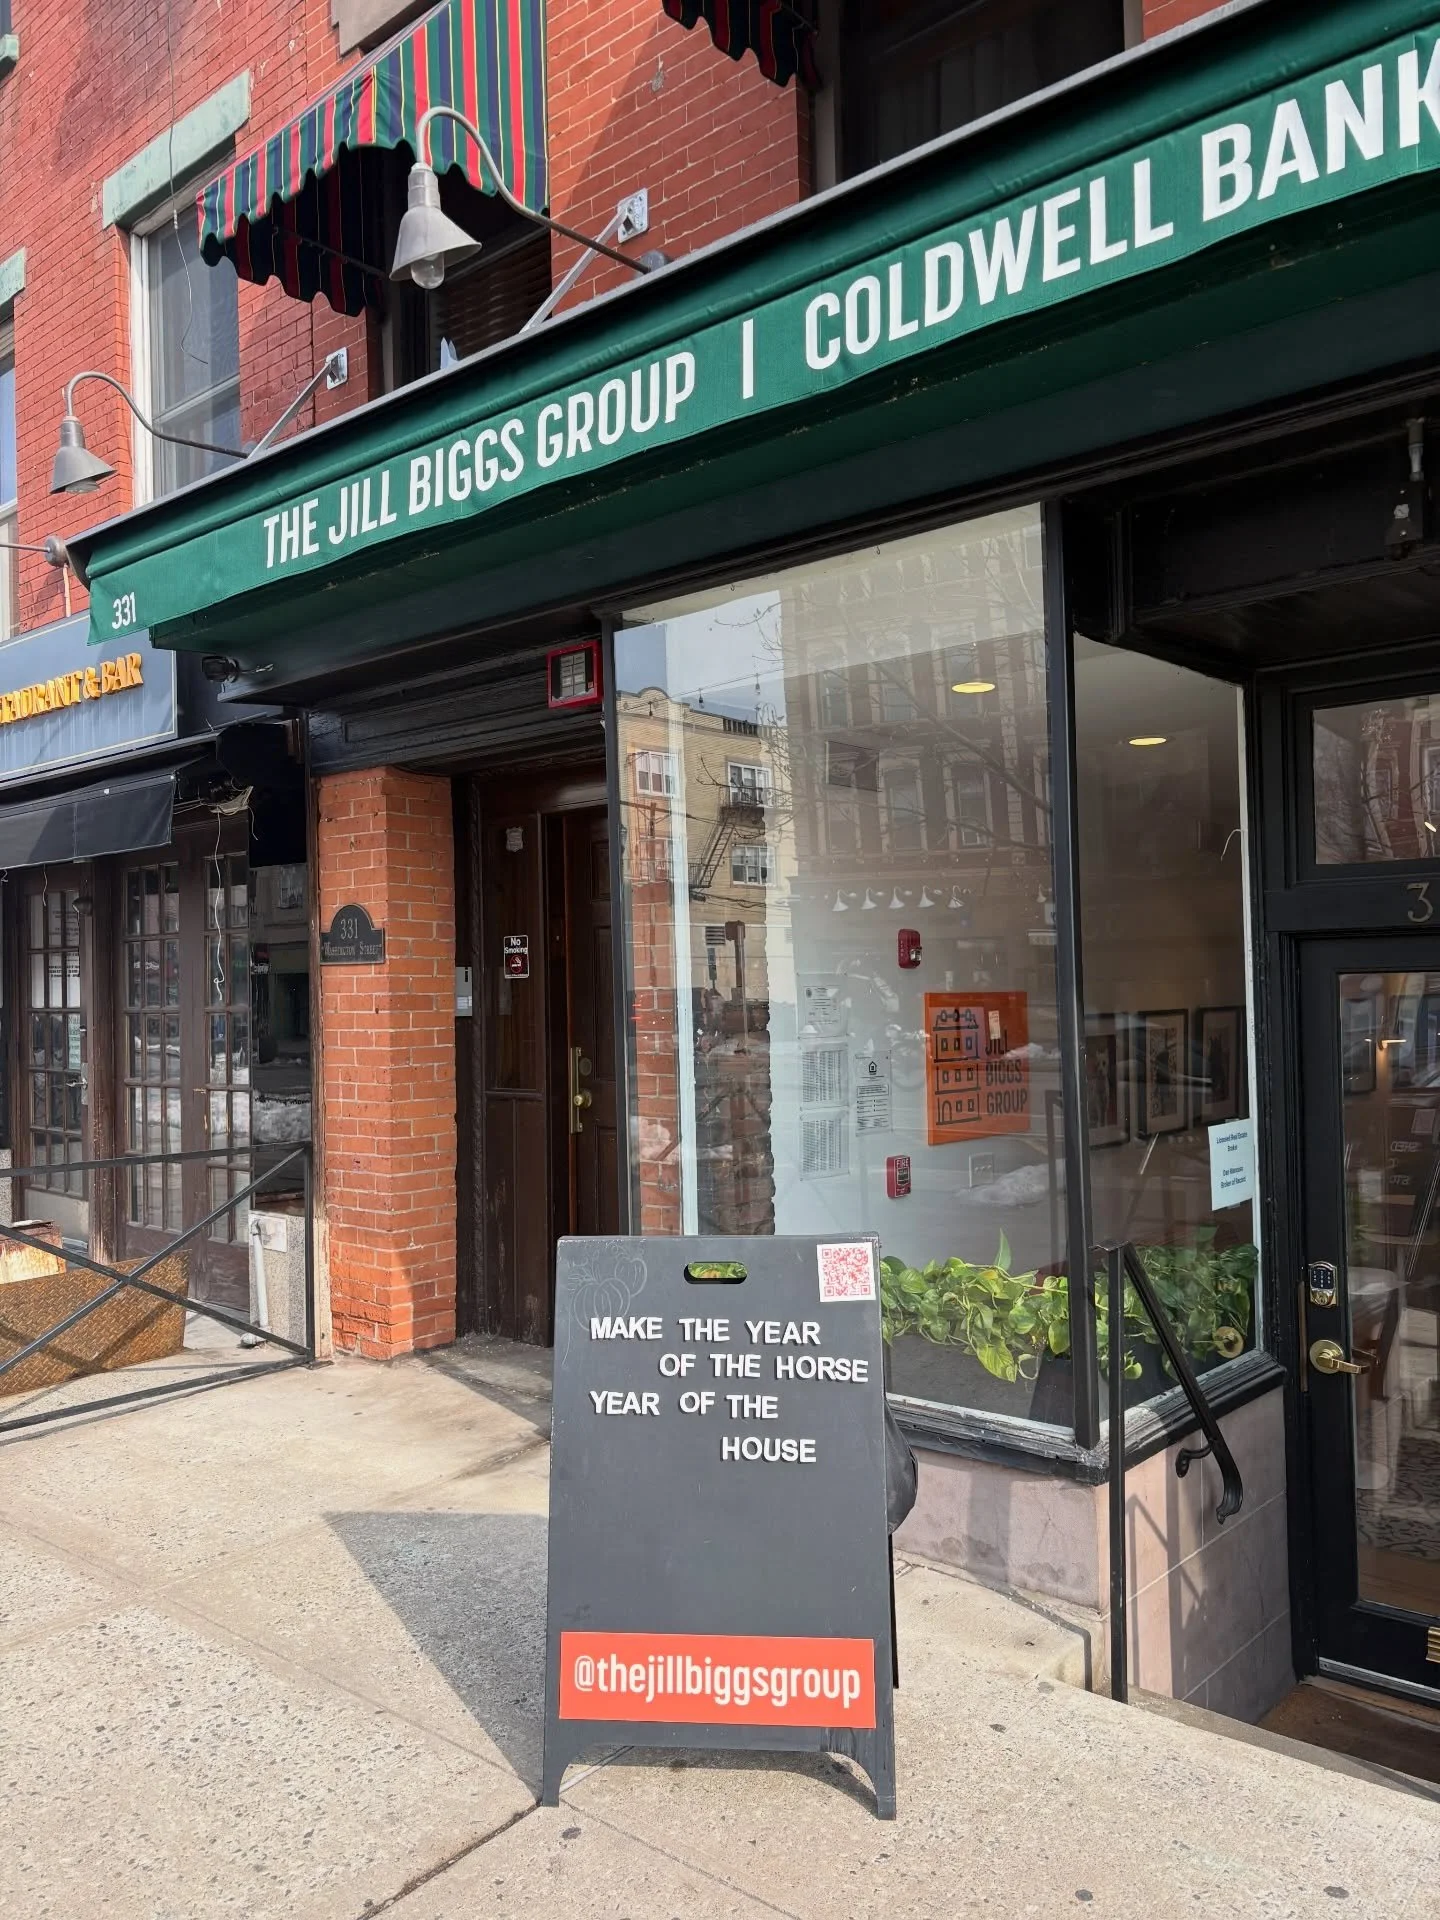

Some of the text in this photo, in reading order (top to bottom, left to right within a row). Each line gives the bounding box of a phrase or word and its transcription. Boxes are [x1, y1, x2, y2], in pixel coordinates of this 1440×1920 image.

[263, 497, 320, 569] THE
[329, 469, 398, 545] JILL
[408, 418, 525, 516] BIGGS
[536, 351, 696, 470] GROUP
[804, 157, 1175, 370] COLDWELL
[1201, 37, 1440, 223] BANK
[111, 591, 137, 630] 331
[0, 671, 83, 724] TAURANT
[100, 652, 144, 695] BAR
[1406, 881, 1433, 923] 3
[340, 918, 358, 939] 331
[510, 937, 521, 946] No
[504, 946, 528, 954] Smoking
[985, 1059, 1023, 1086] BIGGS
[986, 1089, 1028, 1115] GROUP
[590, 1316, 822, 1345] MAKE THE YEAR
[659, 1353, 869, 1383] OF THE HORSE
[590, 1390, 779, 1419] YEAR OF THE
[722, 1436, 817, 1463] HOUSE
[574, 1653, 861, 1709] @thejillbiggsgroup
